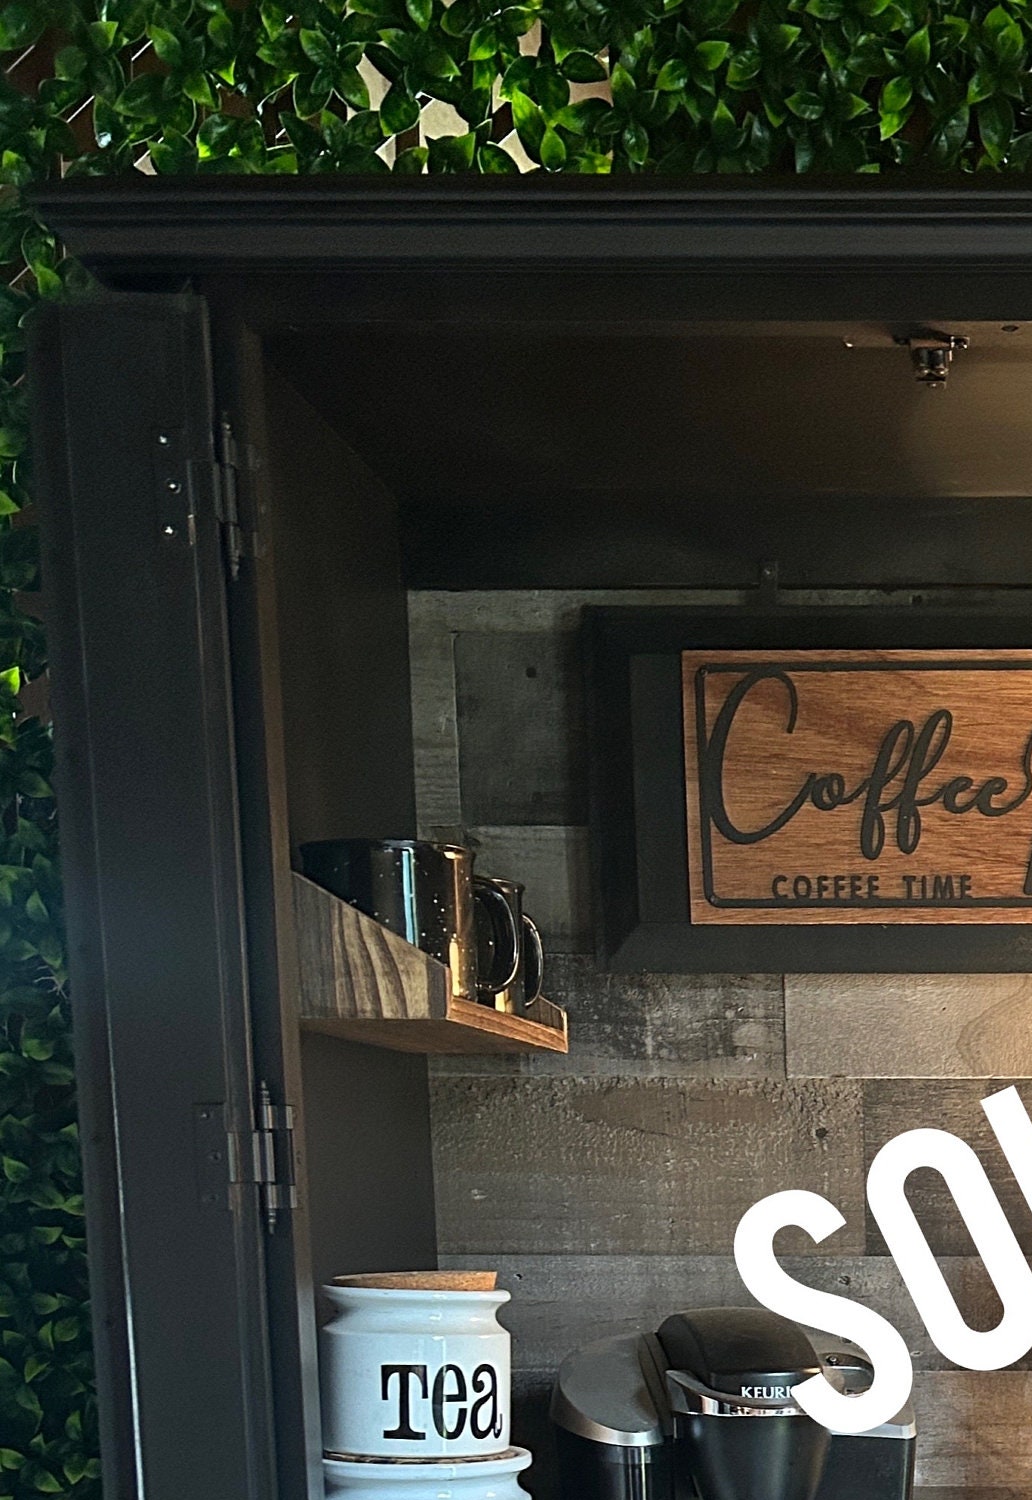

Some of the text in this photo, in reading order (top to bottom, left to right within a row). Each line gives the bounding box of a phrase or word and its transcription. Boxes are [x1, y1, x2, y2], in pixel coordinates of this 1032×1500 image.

[708, 669, 1030, 862] Coffee
[771, 874, 973, 900] COFFEE TIME
[381, 1363, 503, 1441] Tea
[741, 1386, 794, 1399] KEURI
